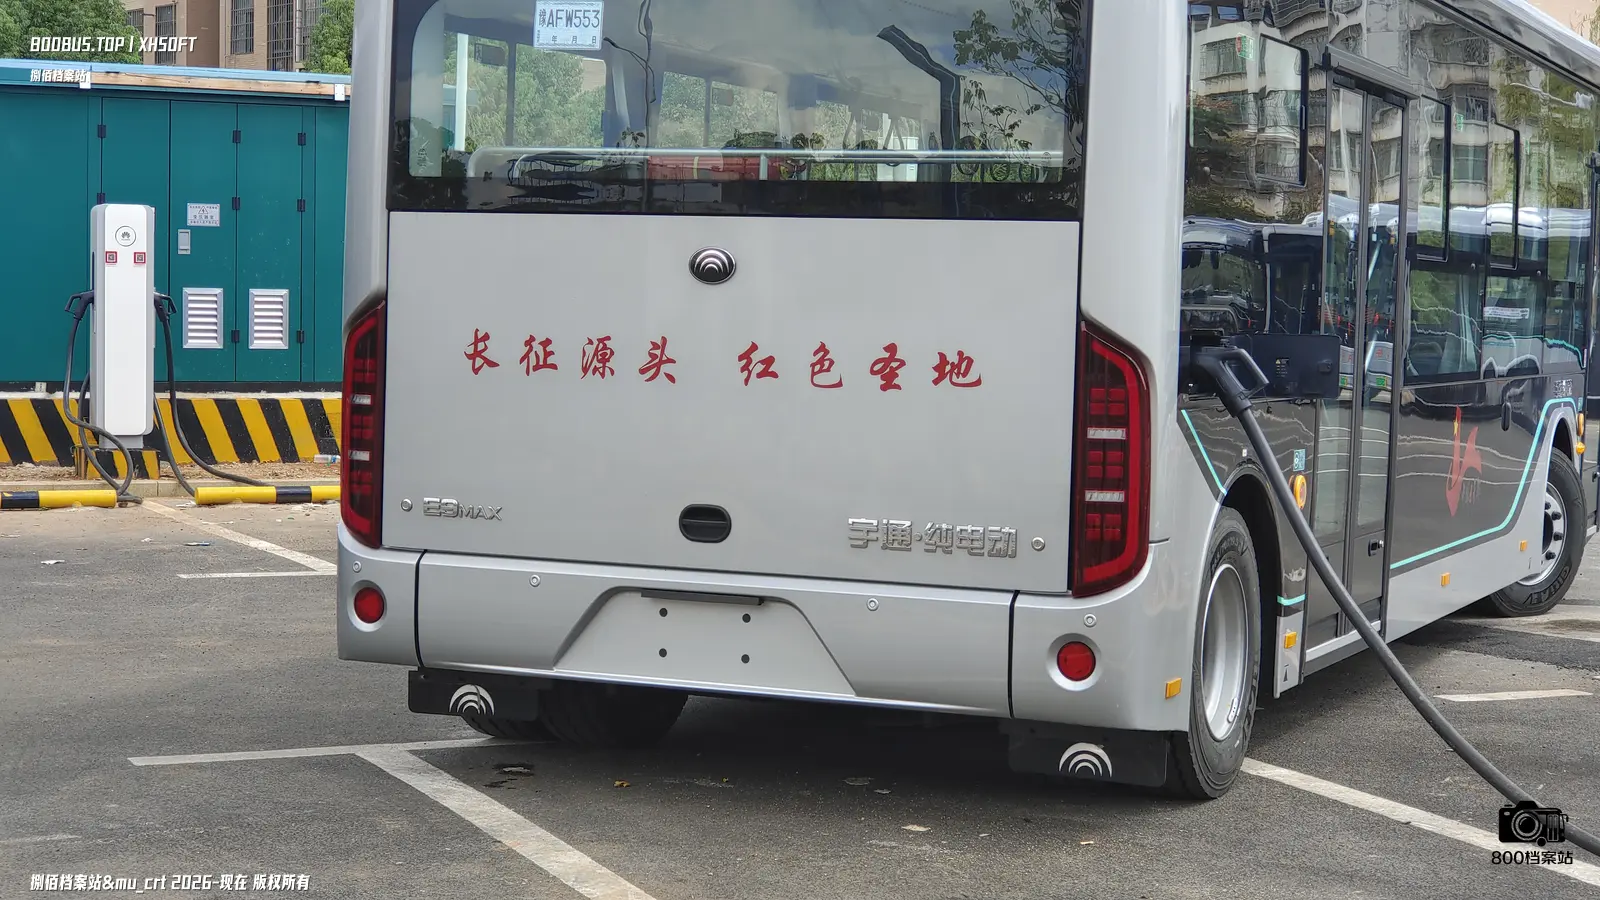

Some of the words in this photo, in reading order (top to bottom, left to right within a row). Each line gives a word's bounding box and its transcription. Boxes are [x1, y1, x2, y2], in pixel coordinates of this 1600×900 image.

[464, 327, 677, 385] 长征源头
[737, 340, 982, 392] 红色圣地
